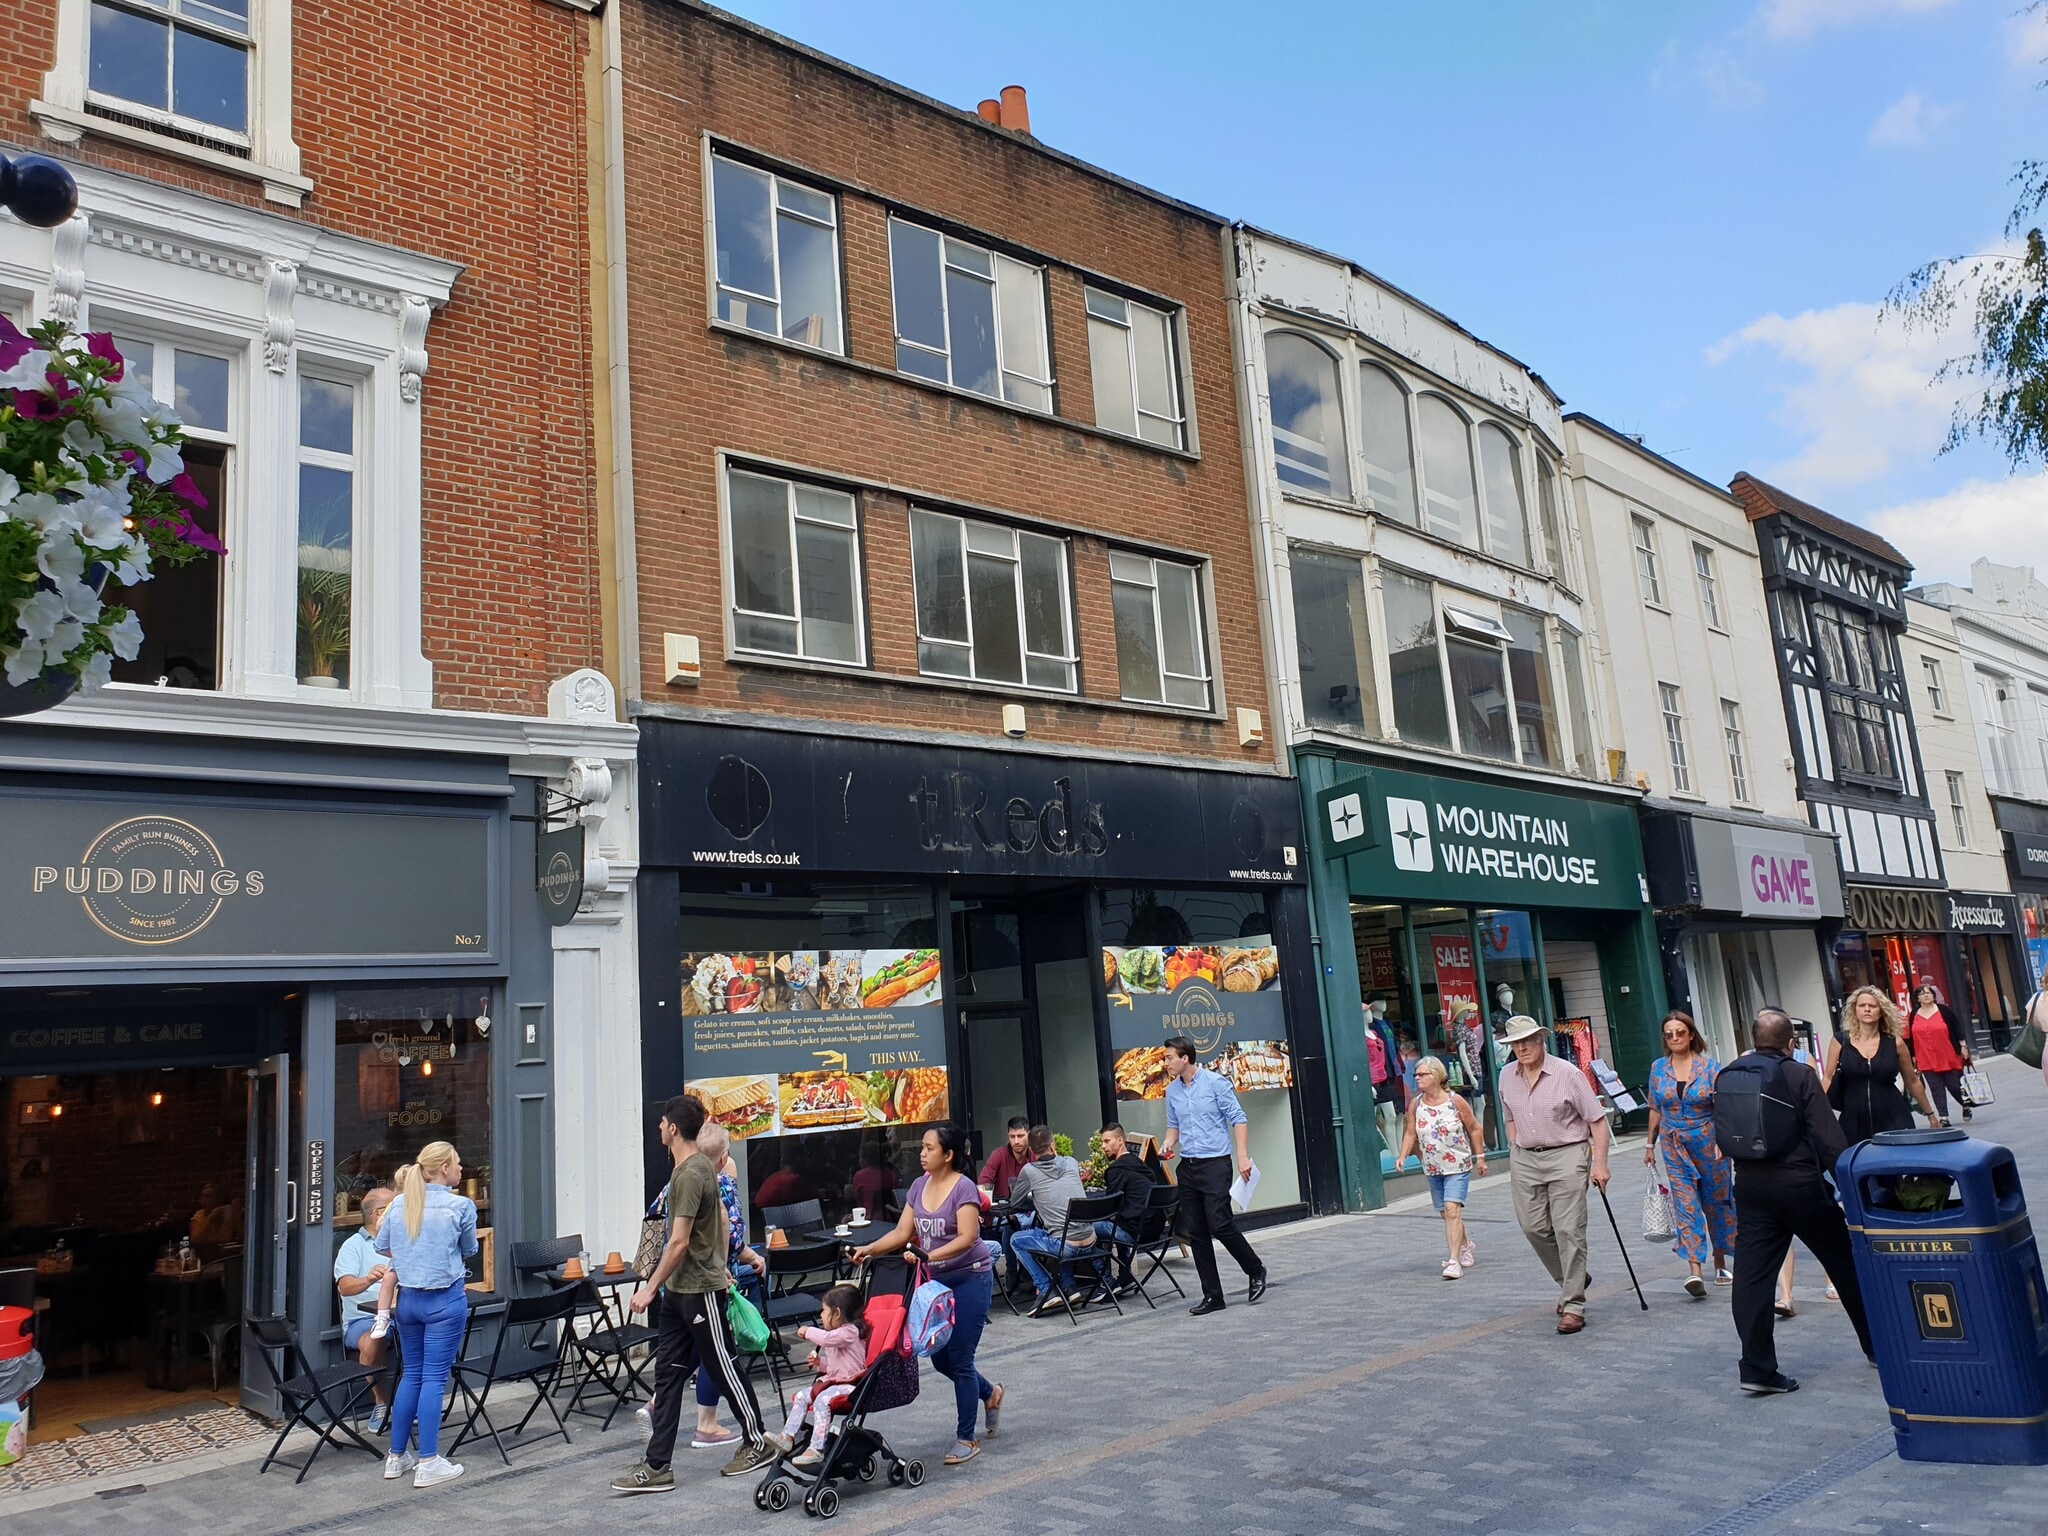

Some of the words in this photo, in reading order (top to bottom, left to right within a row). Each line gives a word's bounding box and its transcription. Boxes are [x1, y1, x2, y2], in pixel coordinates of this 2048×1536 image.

[1435, 803, 1570, 847] MOUNTAIN
[111, 833, 140, 854] FAMILY
[142, 831, 162, 839] RUN
[163, 832, 199, 856] BUSINESS
[692, 850, 801, 865] www.treds.co.uk
[1440, 843, 1600, 885] WAREHOUSE
[33, 866, 265, 895] PUDDINGS
[540, 870, 580, 888] PUDDINGS
[1228, 868, 1294, 880] www.treds.co.uk
[1751, 854, 1815, 906] GAME
[1849, 888, 1940, 930] ONSOON
[1949, 896, 2005, 931] Accessorize
[129, 917, 155, 928] SINCE
[157, 917, 177, 927] 1982
[454, 935, 481, 945] No.7
[1435, 947, 1470, 968] SALE
[1893, 960, 1917, 975] SAE
[694, 1019, 718, 1028] Gelato
[719, 1019, 729, 1027] ice
[758, 1016, 771, 1025] soft
[773, 1018, 791, 1026] scoop
[826, 1012, 861, 1021] milkshakes,
[863, 1011, 894, 1020] smoothies,
[1162, 1011, 1235, 1028] PUDDINGS
[9, 1027, 106, 1048] COFFEE
[113, 1026, 131, 1043] &
[139, 1023, 203, 1041] CAKE
[389, 1033, 409, 1044] fresh
[412, 1032, 441, 1045] ground
[694, 1031, 712, 1039] fresh
[713, 1030, 735, 1040] juices,
[737, 1028, 769, 1039] pancakes,
[771, 1026, 796, 1035] waffles,
[798, 1025, 816, 1034] cakes,
[818, 1024, 844, 1032] desserts,
[846, 1022, 865, 1031] salads,
[867, 1021, 887, 1031] freshly
[889, 1020, 915, 1031] prepared
[694, 1042, 730, 1052] baguettes,
[731, 1039, 771, 1049] sandwiches,
[773, 1037, 799, 1046] toasties,
[800, 1036, 819, 1046] jacket
[821, 1036, 848, 1045] potatoes,
[850, 1033, 869, 1043] bagels
[871, 1032, 882, 1040] and
[380, 1045, 450, 1062] COFFEE
[870, 1052, 896, 1064] THIS
[405, 1100, 426, 1111] great
[388, 1109, 442, 1127] FOOD
[310, 1141, 323, 1186] COFFEE
[309, 1189, 322, 1222] SHOP
[1889, 1242, 1954, 1252] LITTER
[633, 1470, 650, 1484] N
